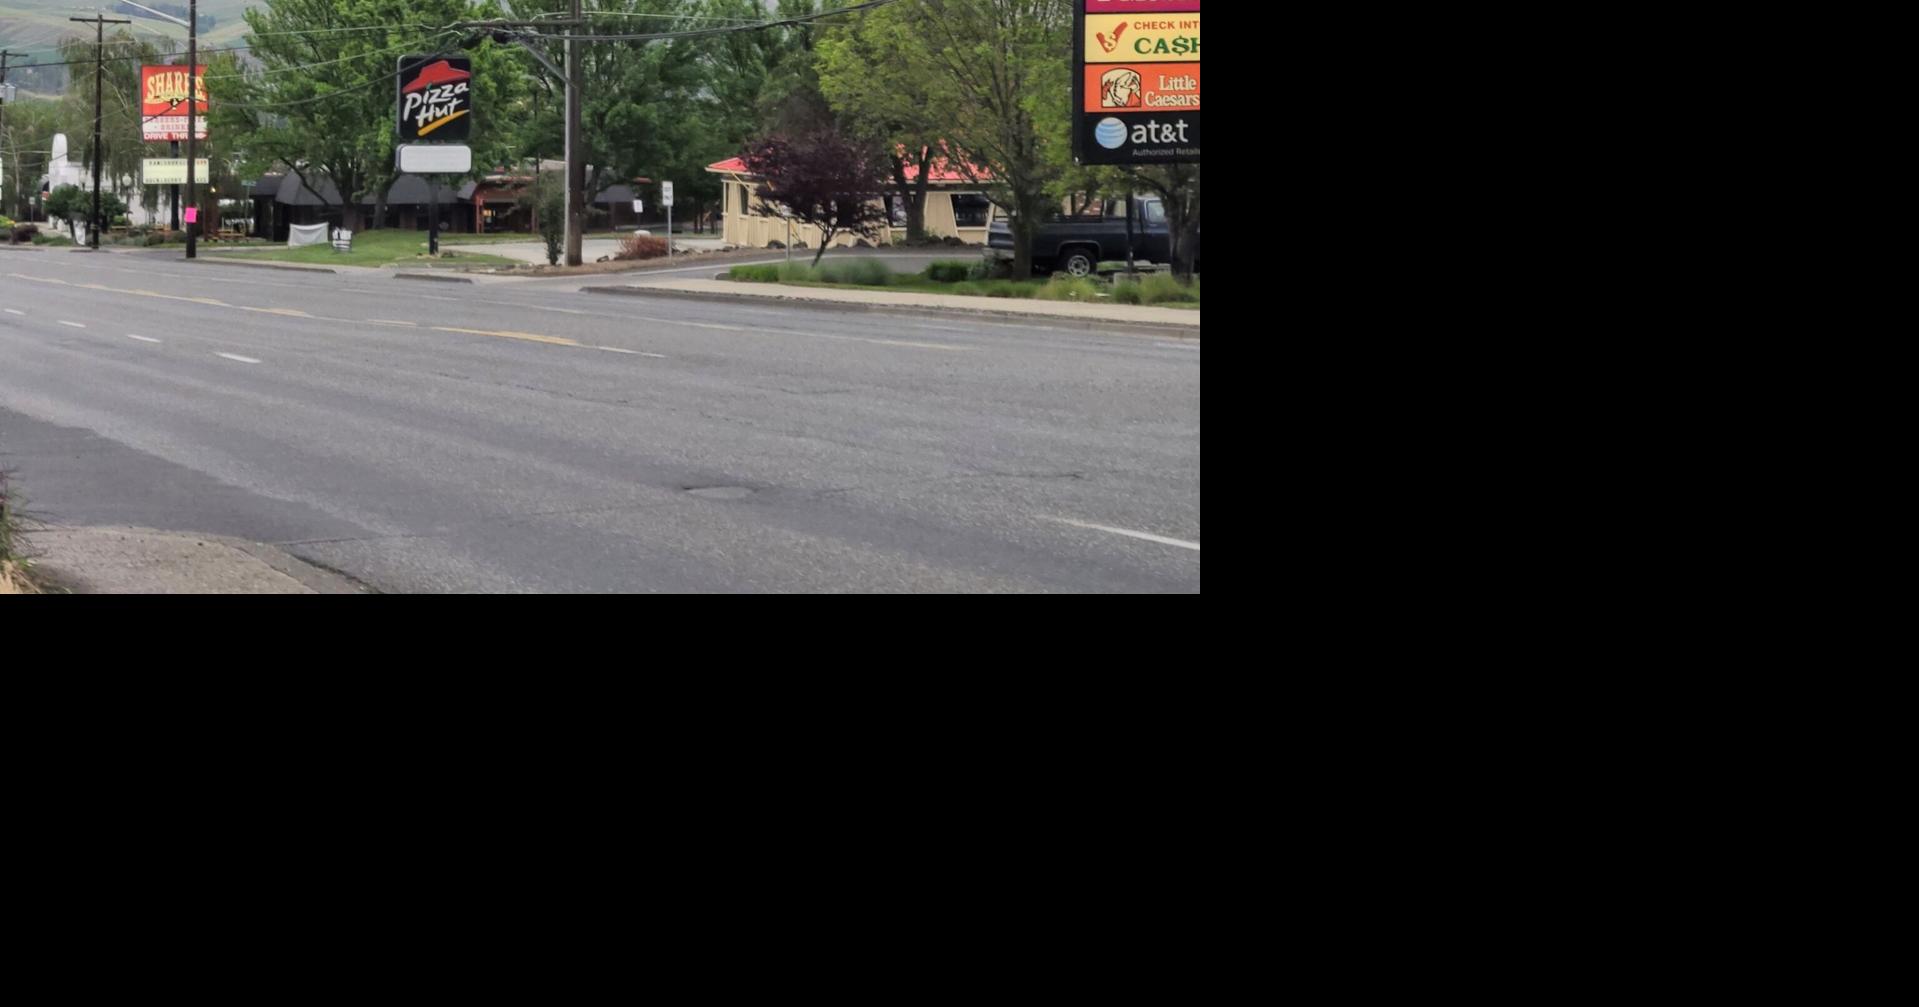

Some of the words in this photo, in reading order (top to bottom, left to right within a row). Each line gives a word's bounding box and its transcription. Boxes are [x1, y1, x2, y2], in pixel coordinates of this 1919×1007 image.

[1134, 21, 1175, 30] CHECK
[1159, 75, 1196, 91] Little
[403, 82, 470, 121] Pizza
[1145, 91, 1200, 107] Caesars
[415, 97, 464, 127] Hut
[144, 132, 168, 140] DRIVE
[1131, 119, 1189, 144] at&t
[1132, 147, 1174, 157] Authorized
